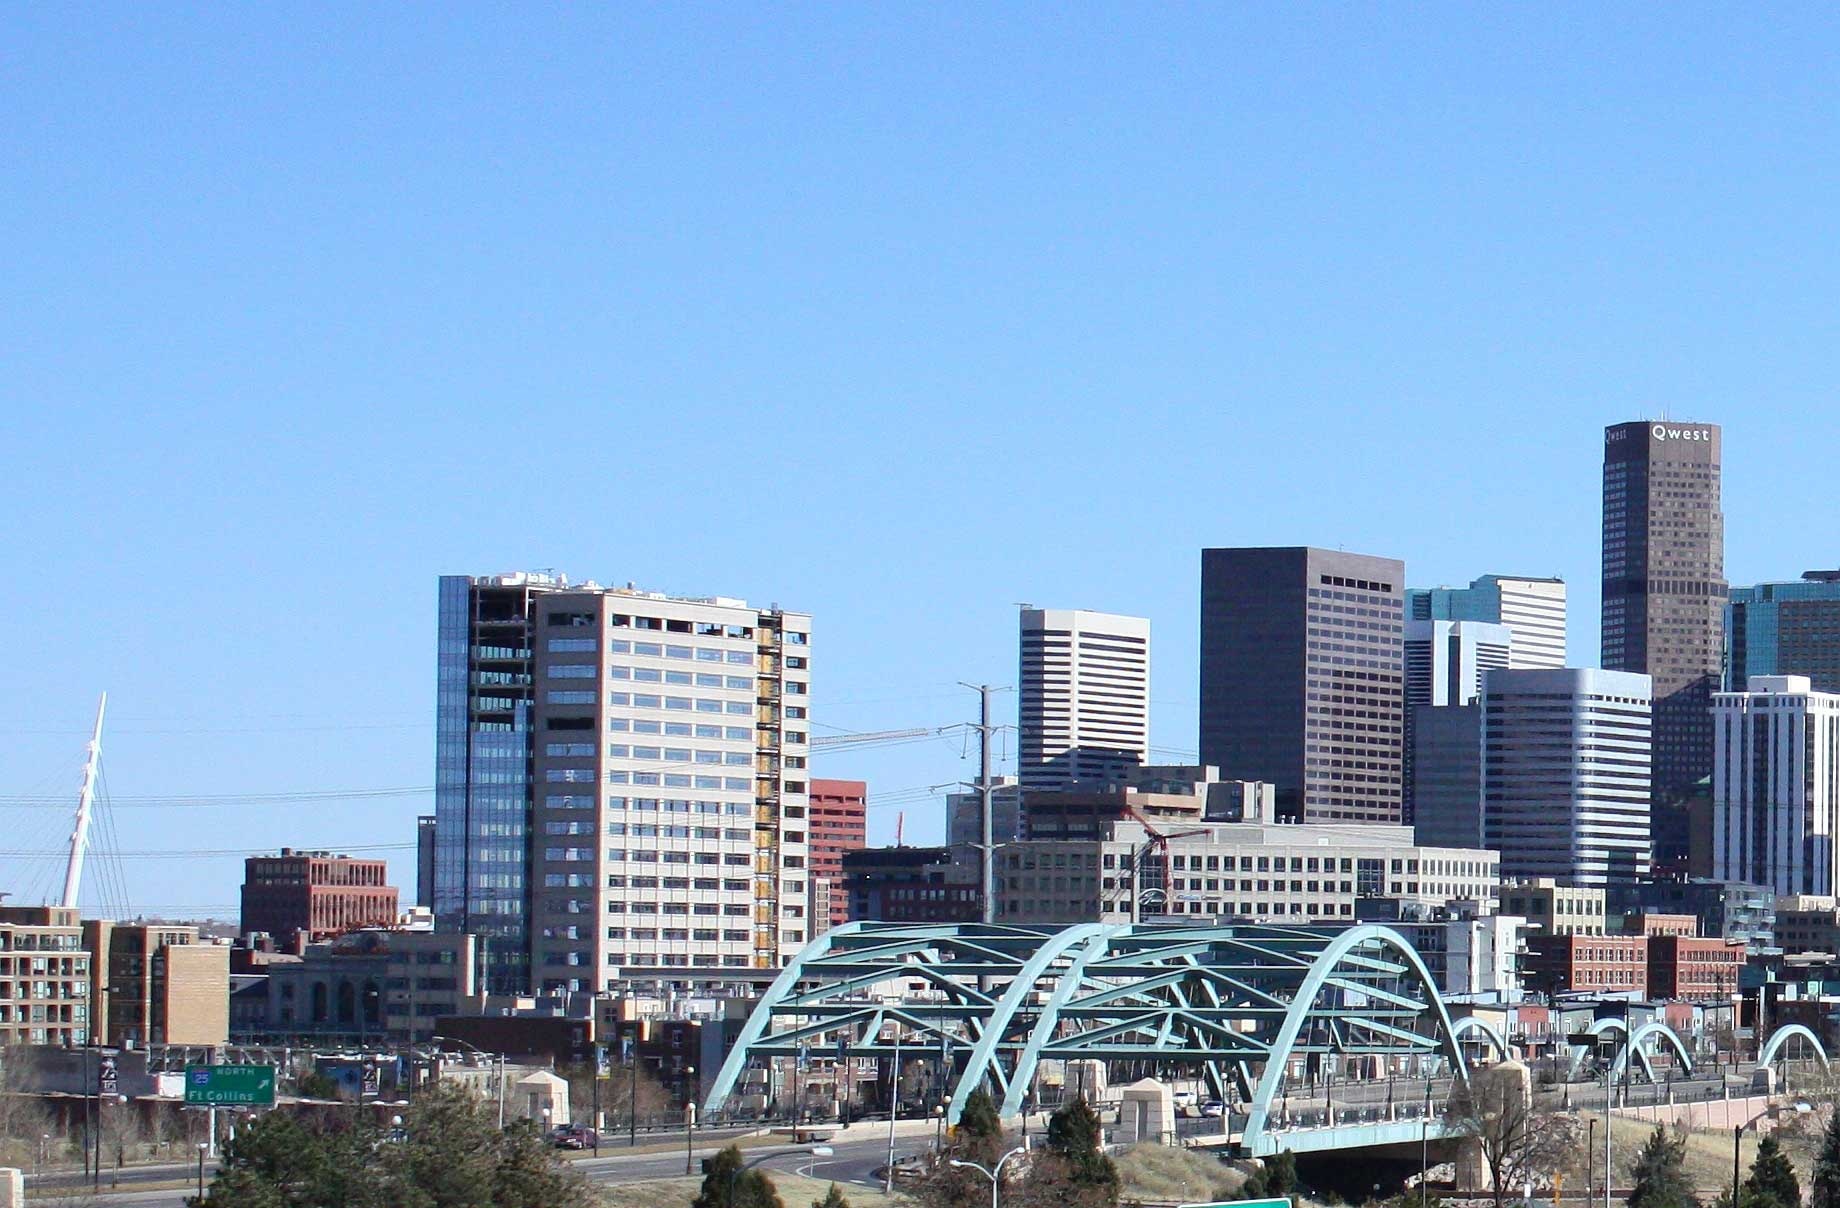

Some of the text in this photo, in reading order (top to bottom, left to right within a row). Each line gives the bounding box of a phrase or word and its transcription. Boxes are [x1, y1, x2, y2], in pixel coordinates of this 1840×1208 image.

[1652, 425, 1709, 441] Qwest
[216, 1068, 255, 1076] NORTH
[195, 1074, 209, 1084] 25
[207, 1090, 254, 1101] Collins
